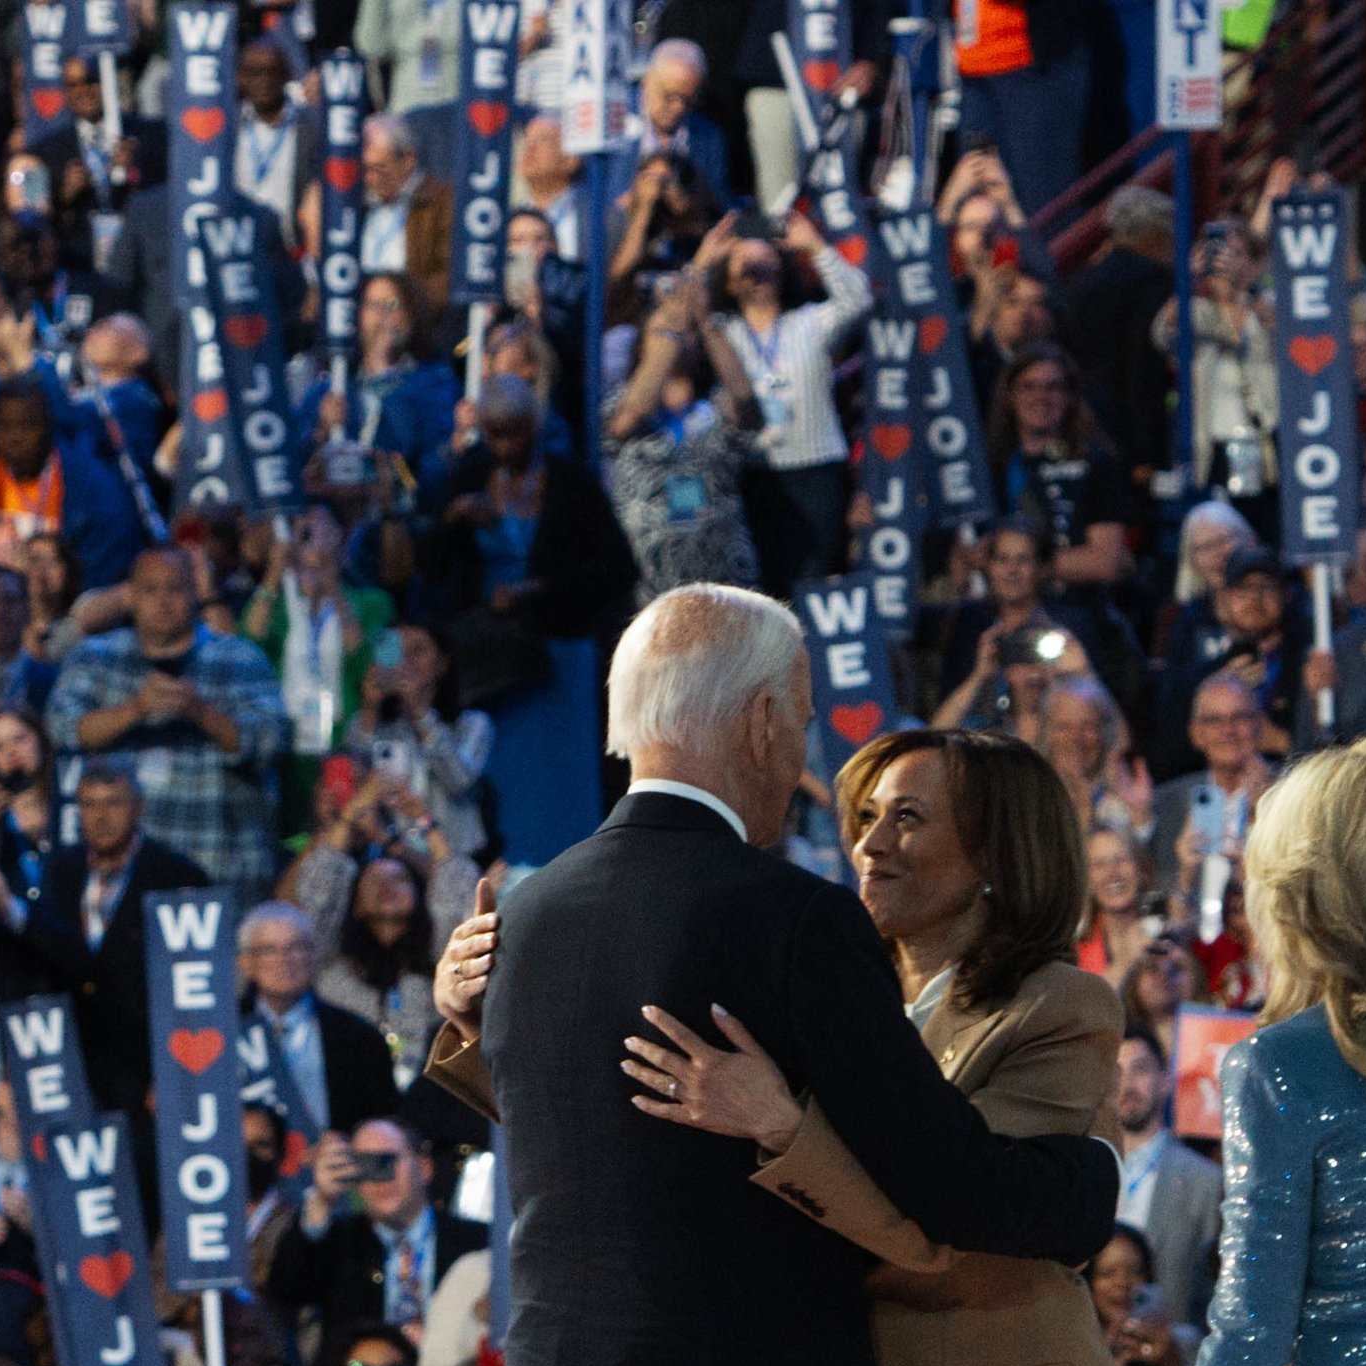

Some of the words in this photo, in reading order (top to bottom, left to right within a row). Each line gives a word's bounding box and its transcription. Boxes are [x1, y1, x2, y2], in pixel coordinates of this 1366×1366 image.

[26, 0, 69, 81] WE
[176, 10, 230, 96] WE
[466, 3, 516, 89] WE
[320, 61, 365, 147] WE
[463, 151, 502, 283] JOE
[321, 212, 363, 338] JOE
[1278, 223, 1338, 321] WE
[204, 216, 257, 303] WE
[237, 364, 295, 496] JOE
[868, 318, 917, 410] WE
[878, 213, 935, 303] WE
[924, 366, 978, 502] JOE
[188, 433, 231, 506] JO
[1295, 392, 1341, 541] JOE
[868, 477, 911, 618] JOE
[808, 587, 873, 690] WE
[156, 902, 221, 1010] WE
[6, 1008, 71, 1115] WE
[54, 1126, 122, 1239] WE
[178, 1093, 232, 1262] JOE
